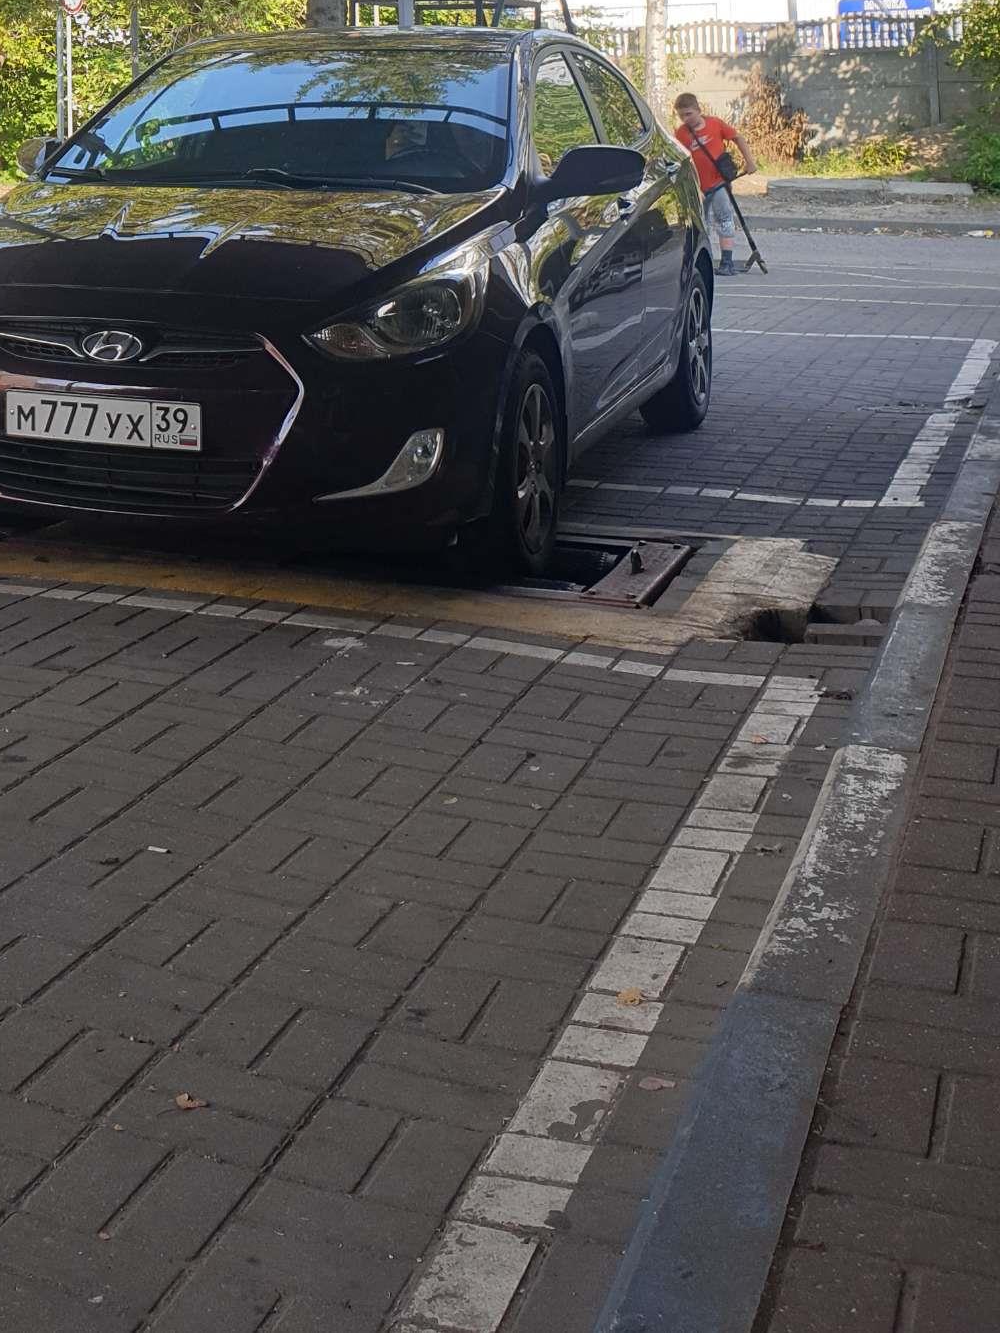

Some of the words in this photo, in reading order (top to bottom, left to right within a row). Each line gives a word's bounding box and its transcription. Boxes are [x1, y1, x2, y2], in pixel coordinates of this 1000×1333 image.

[16, 399, 144, 441] М777УХ
[156, 406, 188, 433] 39
[154, 433, 179, 445] RUS
